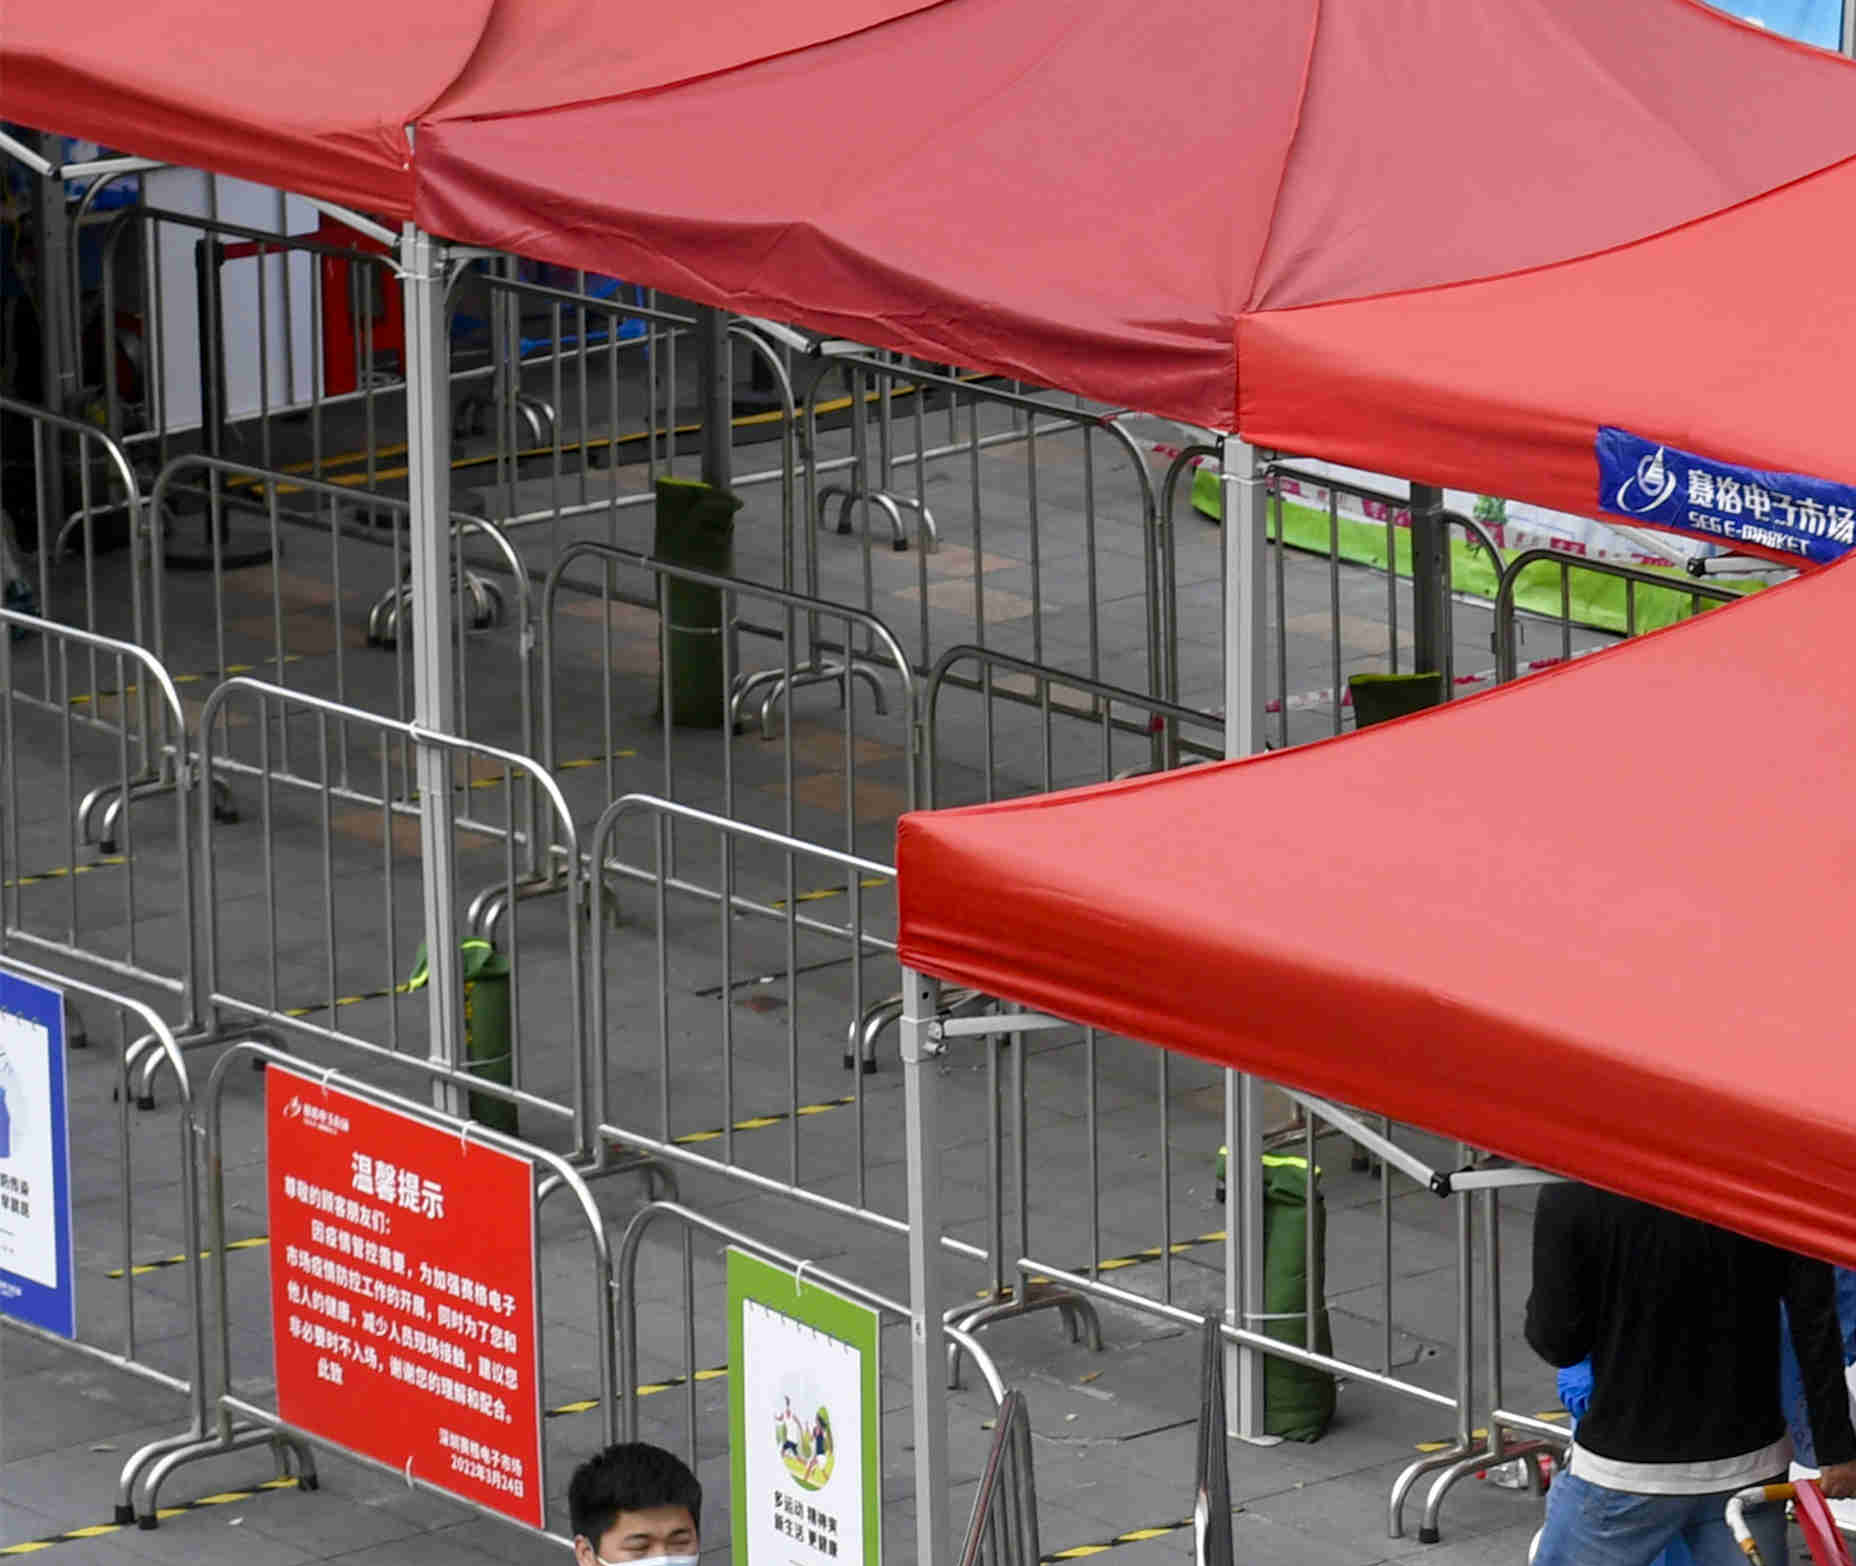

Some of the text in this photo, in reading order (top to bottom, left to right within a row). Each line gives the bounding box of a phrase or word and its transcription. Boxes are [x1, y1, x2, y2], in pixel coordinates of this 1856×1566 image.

[1687, 468, 1855, 545] 赛格电子市场
[1689, 511, 1811, 556] SEG E-MARKET
[351, 1151, 445, 1220] 温馨提示
